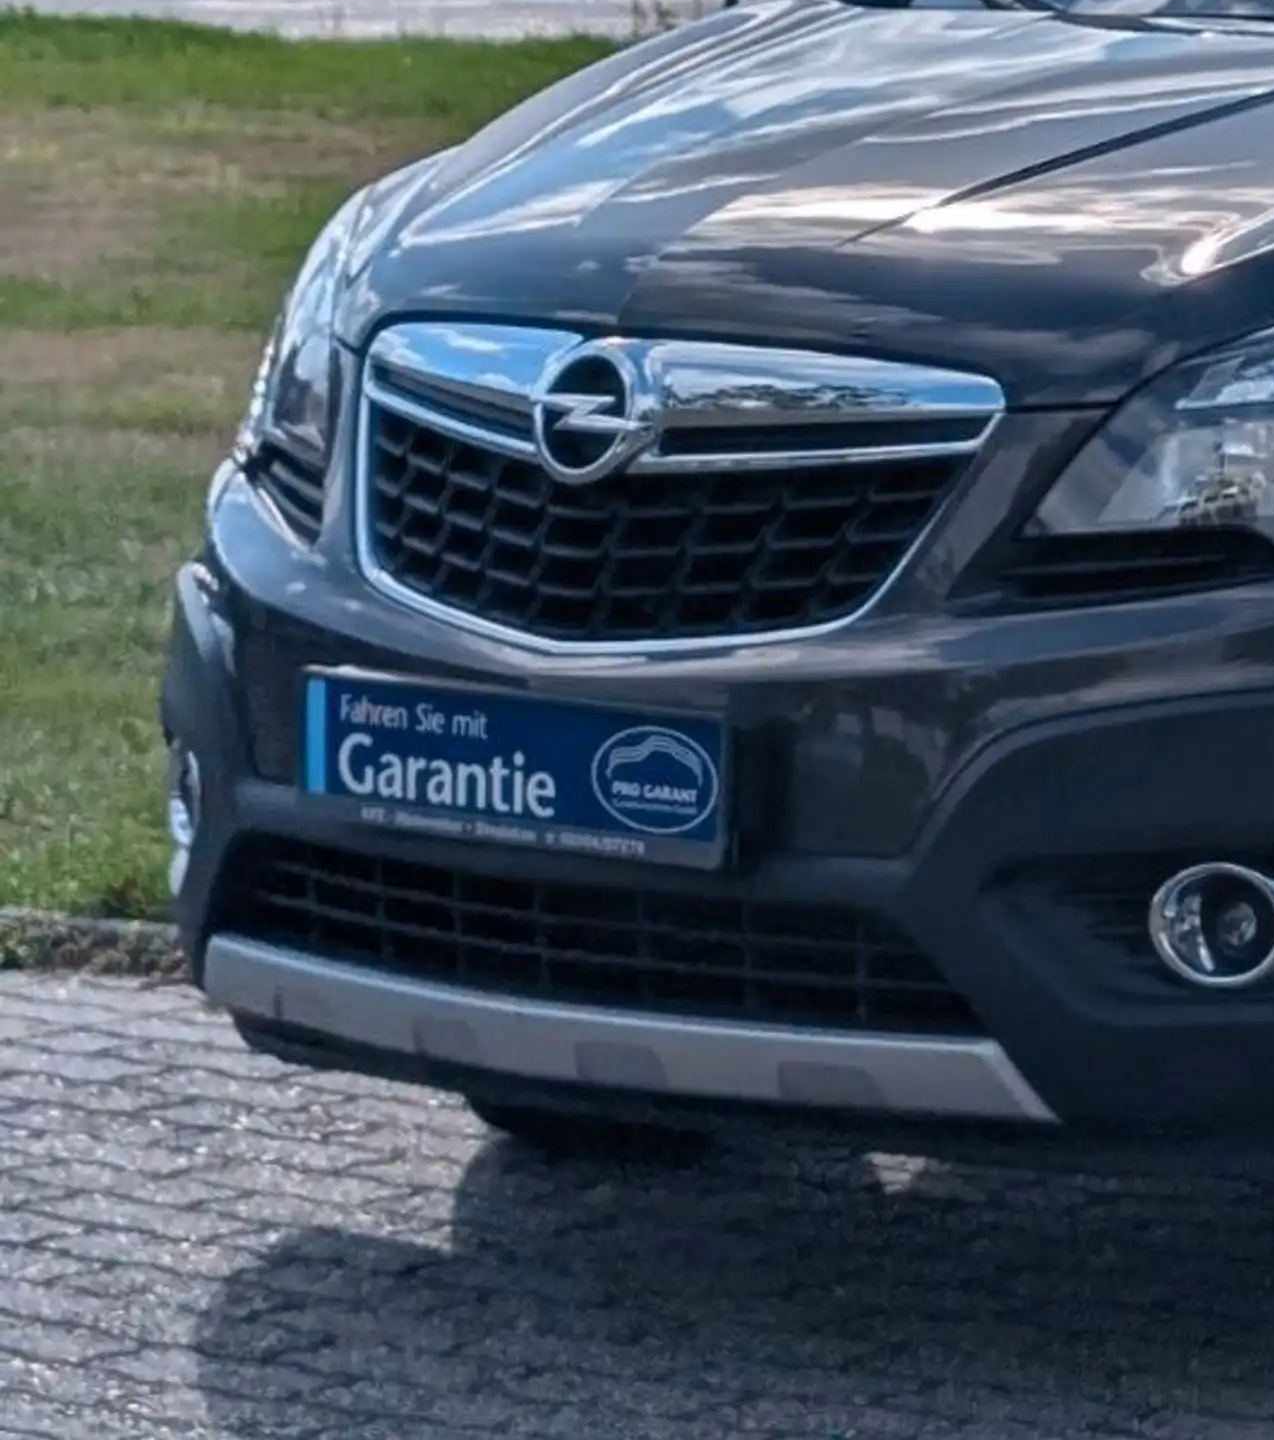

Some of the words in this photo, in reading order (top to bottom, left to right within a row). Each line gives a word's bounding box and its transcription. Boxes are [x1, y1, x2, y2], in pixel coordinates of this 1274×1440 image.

[340, 693, 408, 730] Fahren
[415, 702, 445, 734] Sie
[452, 710, 489, 740] mit
[338, 732, 556, 818] Garantie
[643, 784, 698, 803] GARANT
